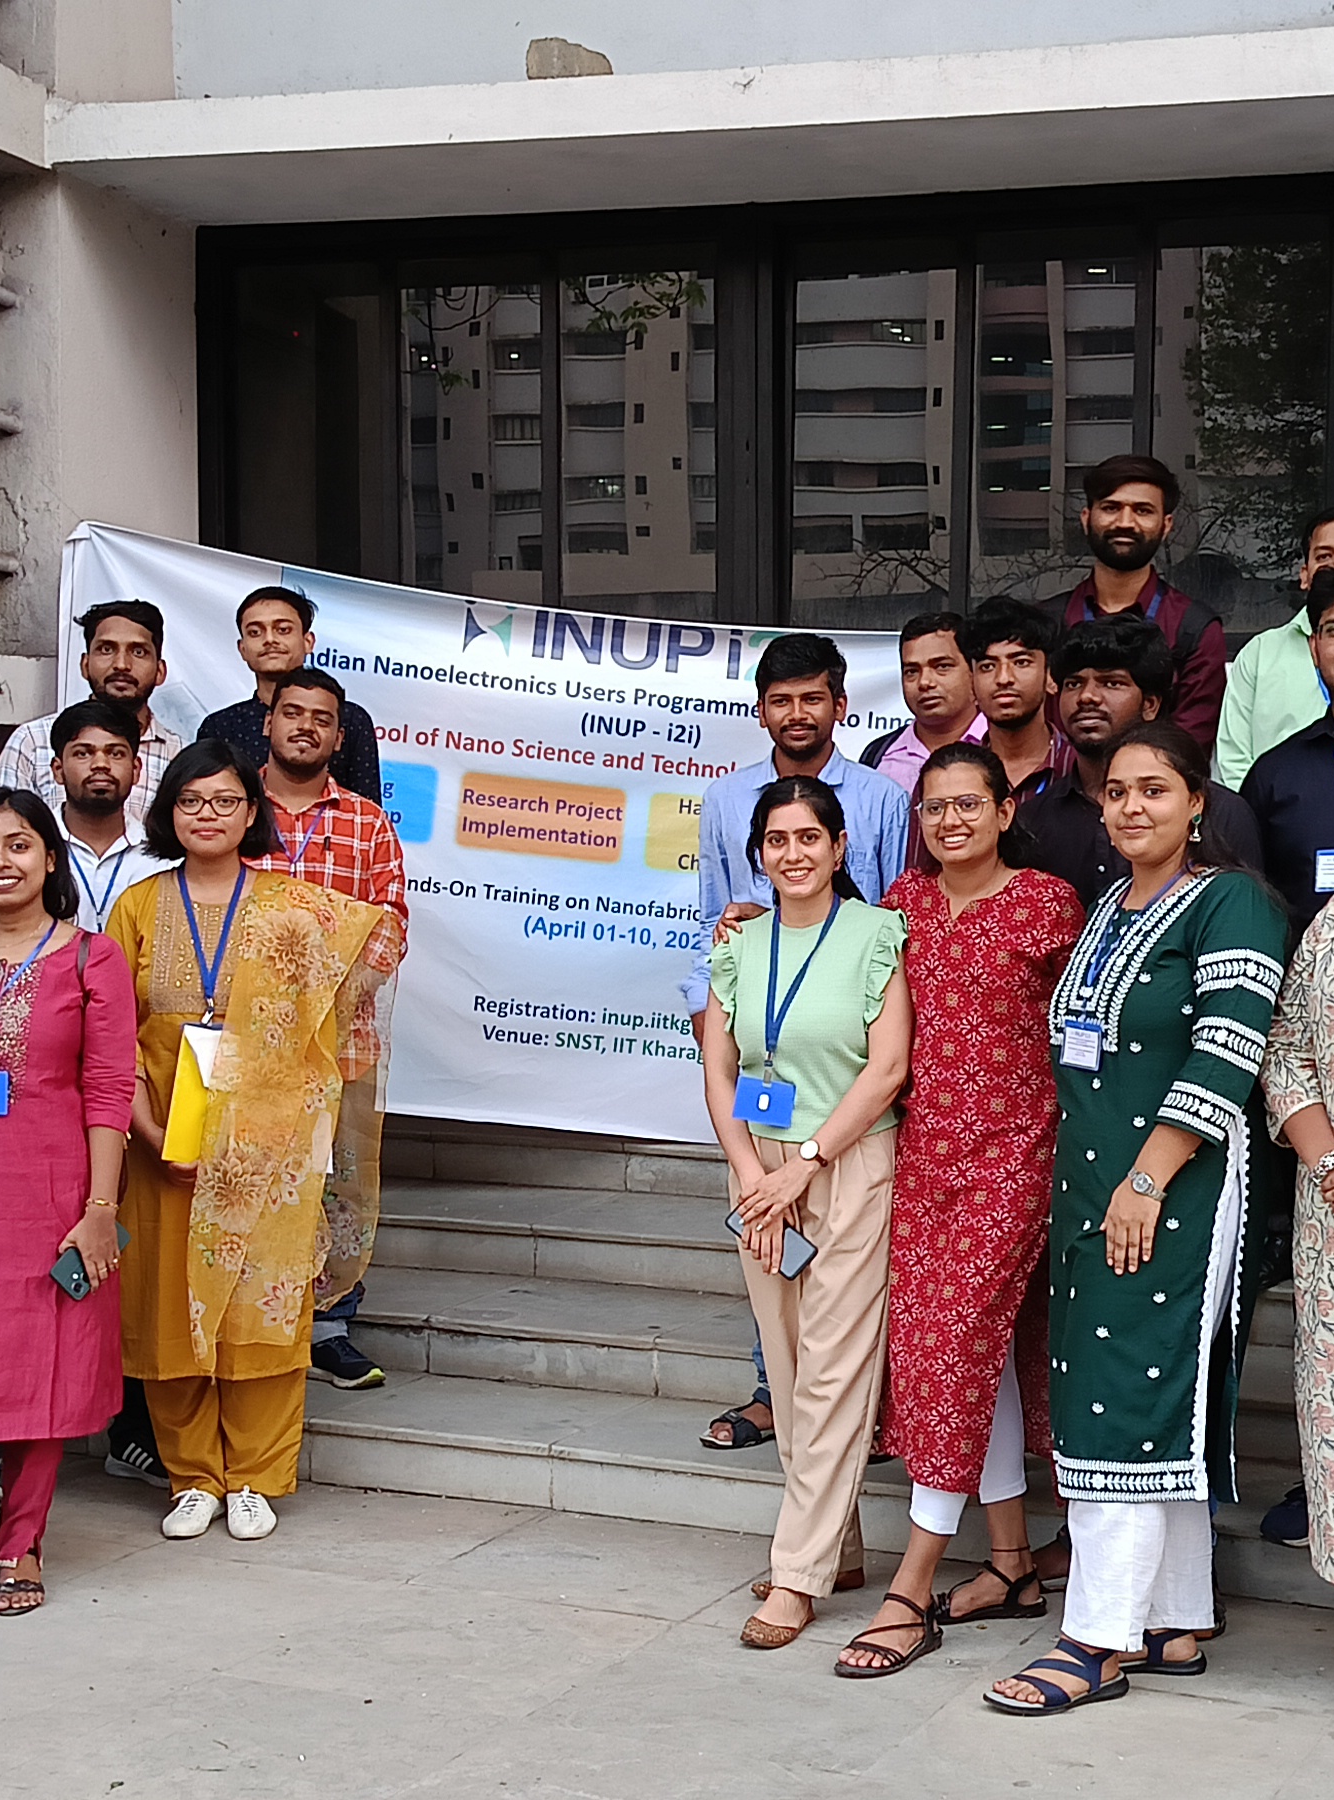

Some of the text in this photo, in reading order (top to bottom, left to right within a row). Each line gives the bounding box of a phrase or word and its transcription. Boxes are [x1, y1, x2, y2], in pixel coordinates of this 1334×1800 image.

[532, 609, 715, 674] INUP
[303, 647, 366, 672] ndian
[373, 654, 557, 696] Nanoelectronics
[564, 680, 626, 704] Users
[374, 723, 408, 744] ool
[415, 727, 440, 747] of
[445, 730, 505, 757] Nano
[512, 737, 596, 766] Science
[602, 746, 645, 772] and
[580, 711, 646, 739] (INUP
[667, 721, 702, 749] i2i)
[463, 788, 624, 822] Research Project
[462, 816, 618, 849] Implementation
[407, 876, 701, 922] nds-On Training on Nanofabric
[523, 914, 702, 950] (April 01-10, 202
[473, 995, 692, 1035] Registration: inup.iitkg
[482, 1024, 704, 1065] Venue: SNST, IIT Kharag
